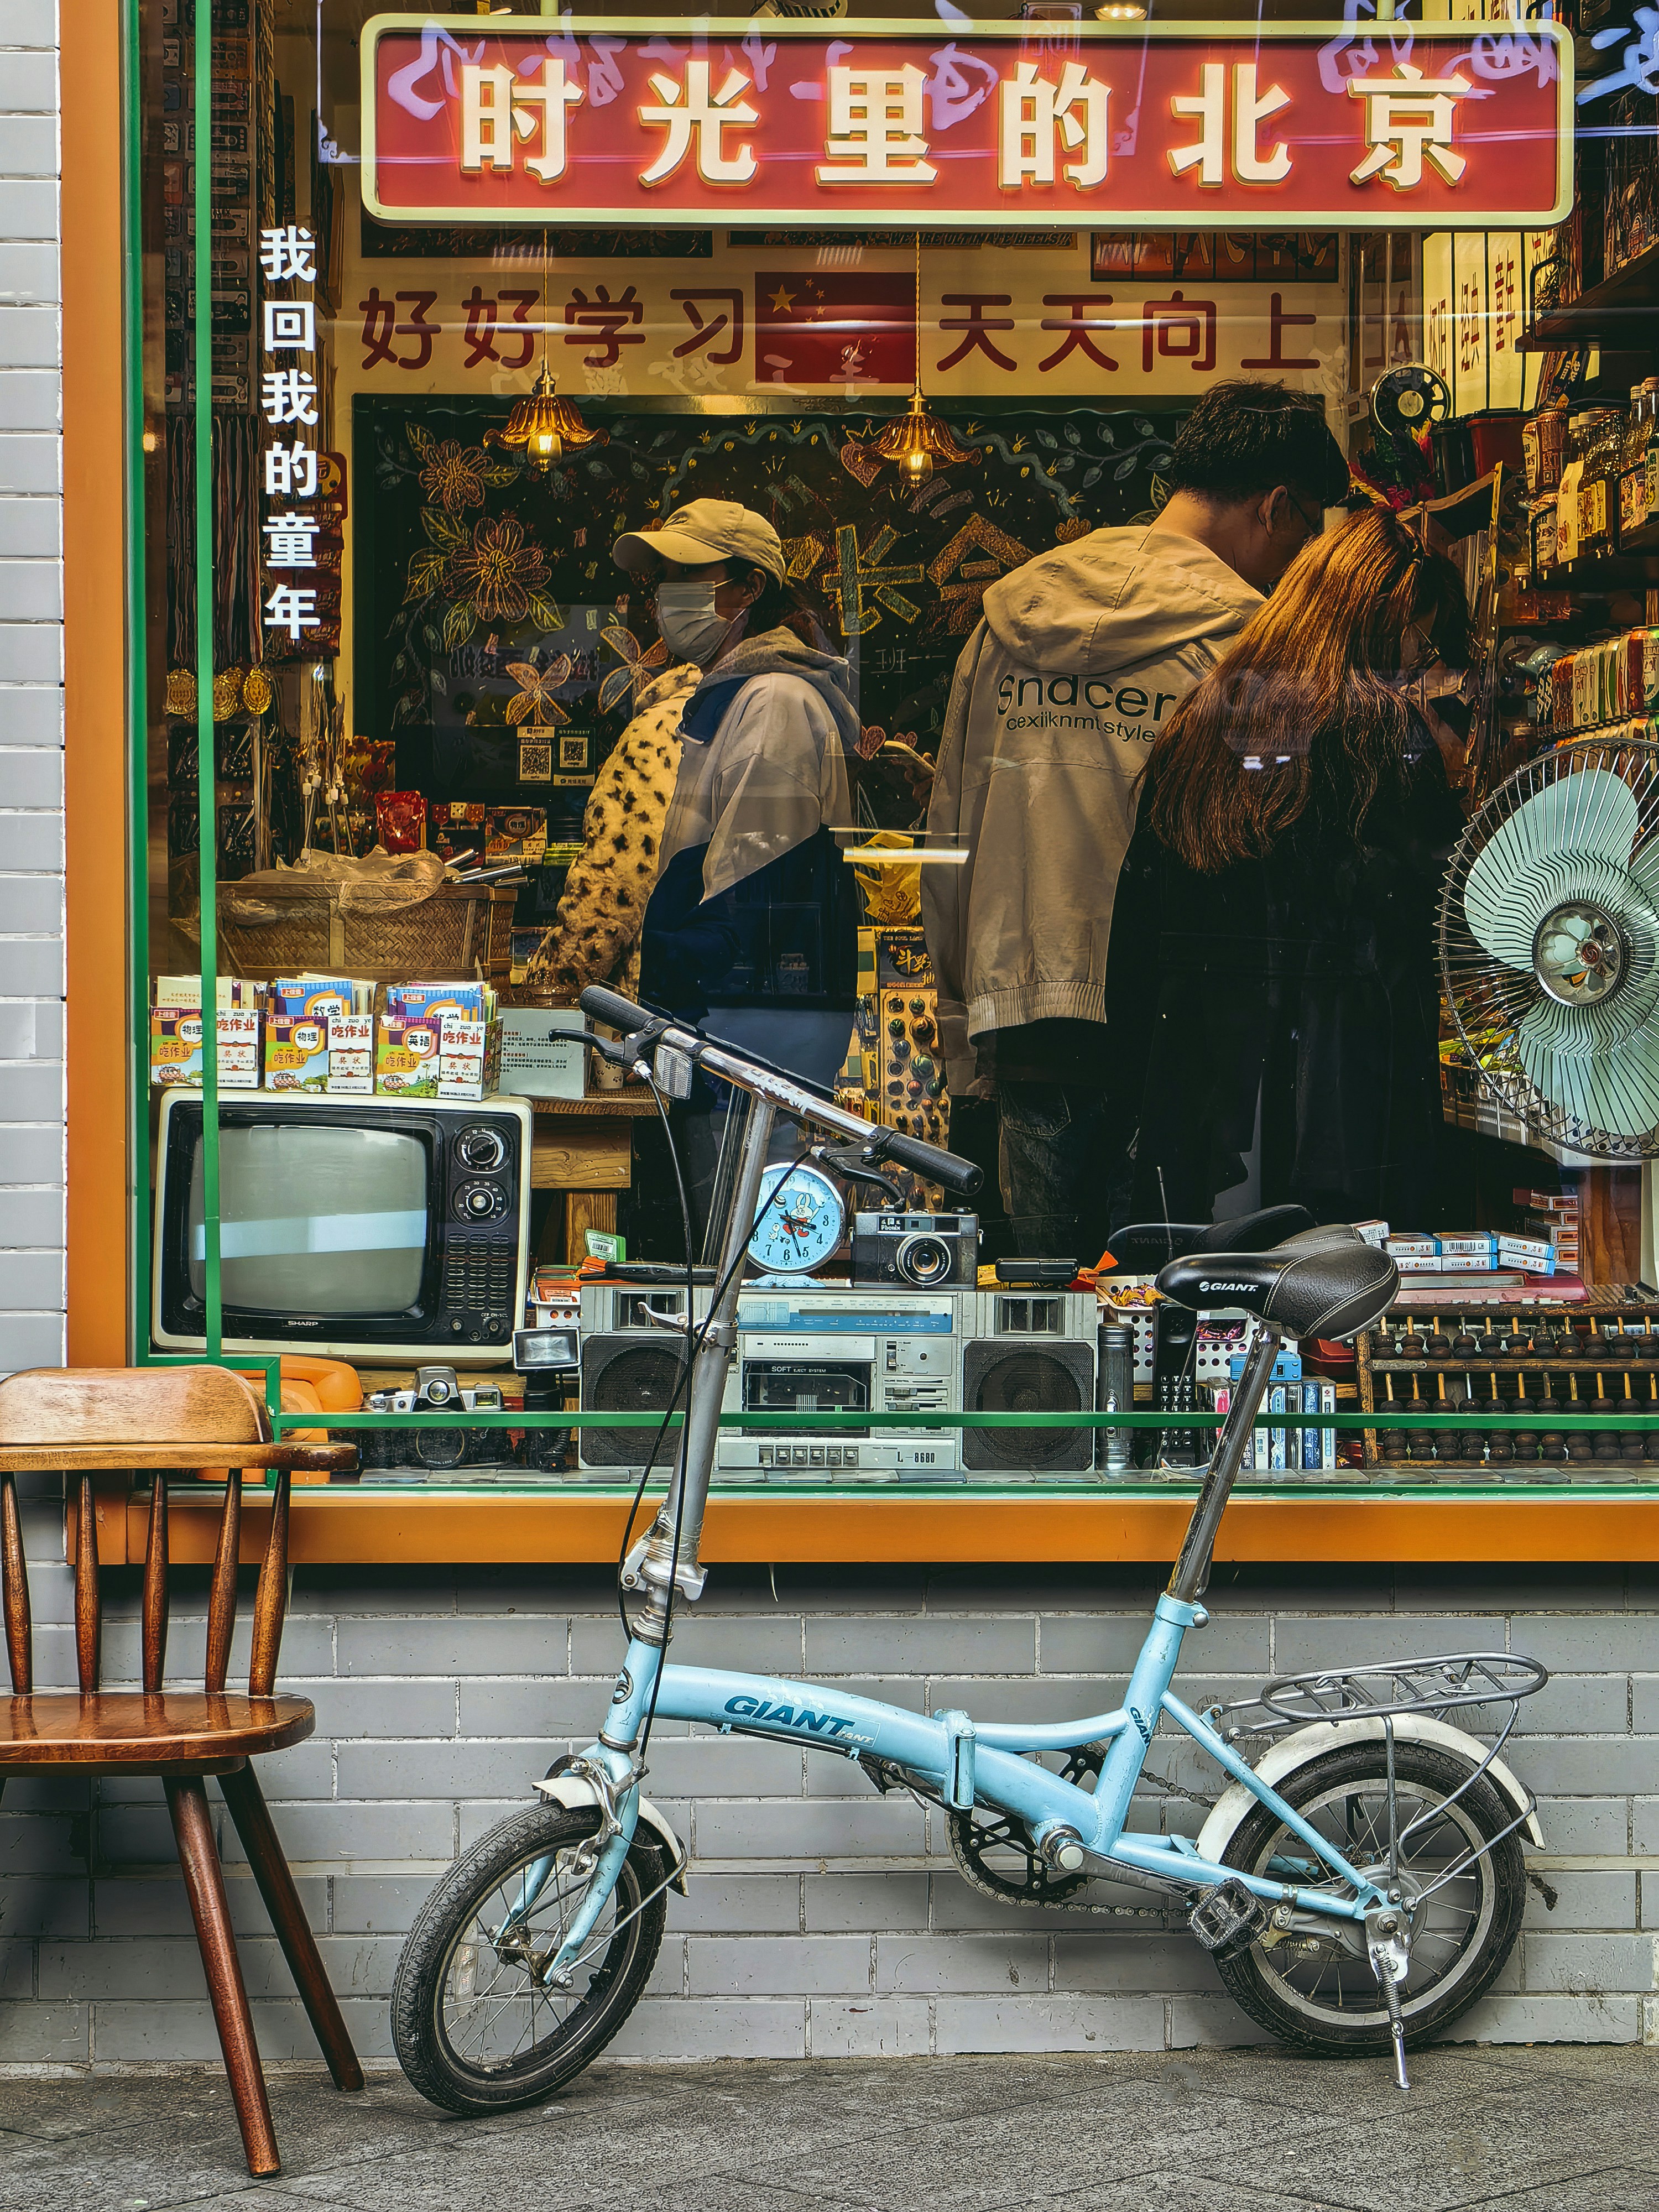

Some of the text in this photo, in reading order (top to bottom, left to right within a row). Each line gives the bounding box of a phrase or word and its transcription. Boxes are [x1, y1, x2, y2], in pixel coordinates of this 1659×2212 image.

[460, 59, 1473, 192] 时光里的北京
[358, 285, 744, 370] 好好学习
[936, 289, 1321, 372] 天天向上
[259, 225, 321, 640] 我回我的童年
[1104, 719, 1156, 743] style
[297, 1031, 317, 1042] 物理
[332, 1025, 370, 1039] 吃作业
[443, 1031, 482, 1045] 吃作业
[408, 1035, 430, 1047] 英语
[159, 1045, 191, 1057] 吃作业
[274, 1053, 306, 1064] 吃作业
[385, 1056, 417, 1068] 吃作业
[822, 1214, 829, 1227] 3
[752, 1230, 759, 1242] 8
[816, 1233, 823, 1244] 4
[765, 1244, 771, 1256] 7
[783, 1249, 790, 1261] 6
[802, 1246, 810, 1258] 5
[1211, 1283, 1258, 1292] GIANT
[724, 1695, 855, 1736] GIANT
